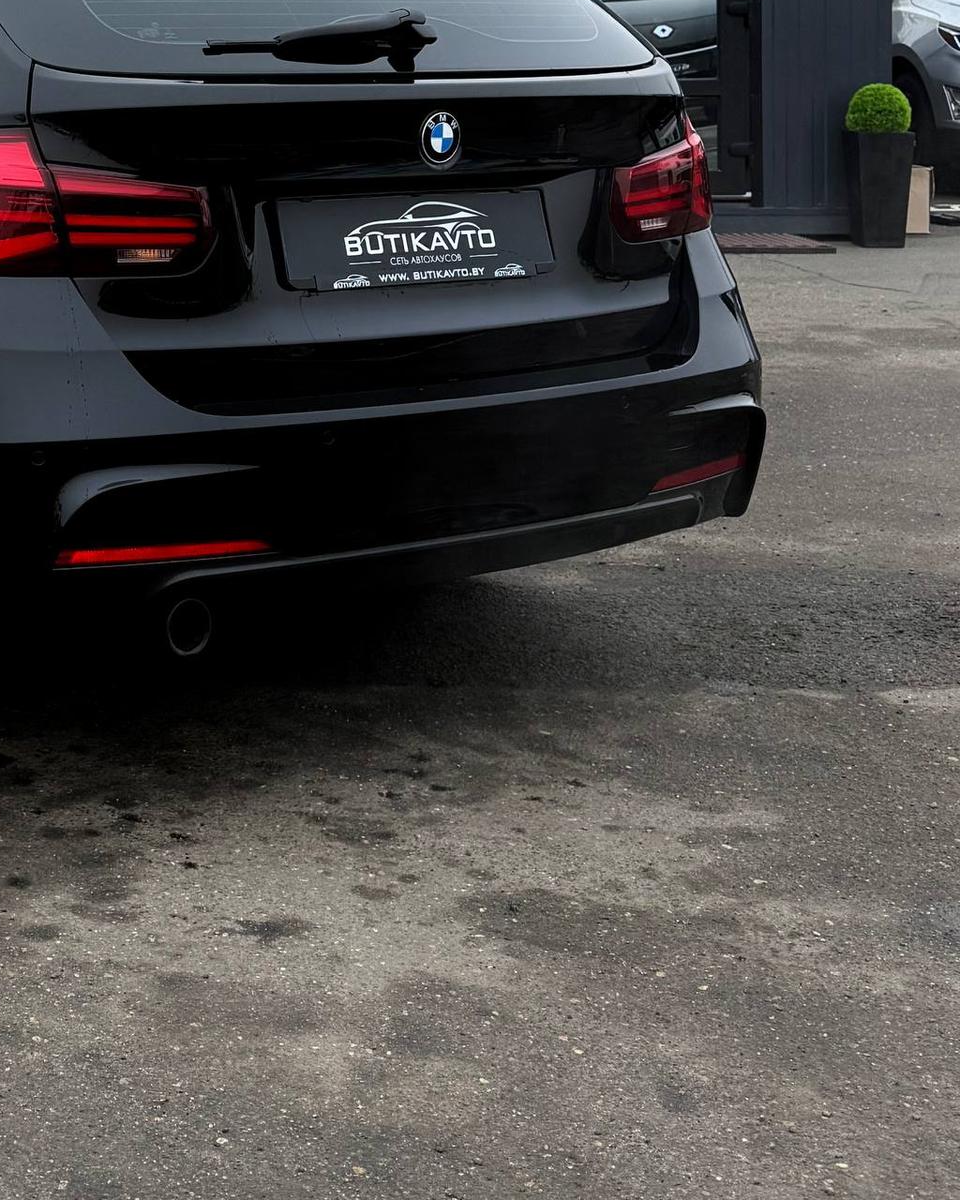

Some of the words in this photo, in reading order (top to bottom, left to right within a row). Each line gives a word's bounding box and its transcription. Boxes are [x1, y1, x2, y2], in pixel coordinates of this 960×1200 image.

[427, 114, 458, 130] BMW
[344, 229, 496, 256] BUTIKAVTO
[390, 256, 409, 265] СЕТЬ
[410, 253, 463, 265] АВТОХАУСОВ
[378, 273, 410, 283] WWW.
[413, 267, 486, 281] BUTIKAVTO.BY
[333, 280, 371, 289] BUTIKAVTO
